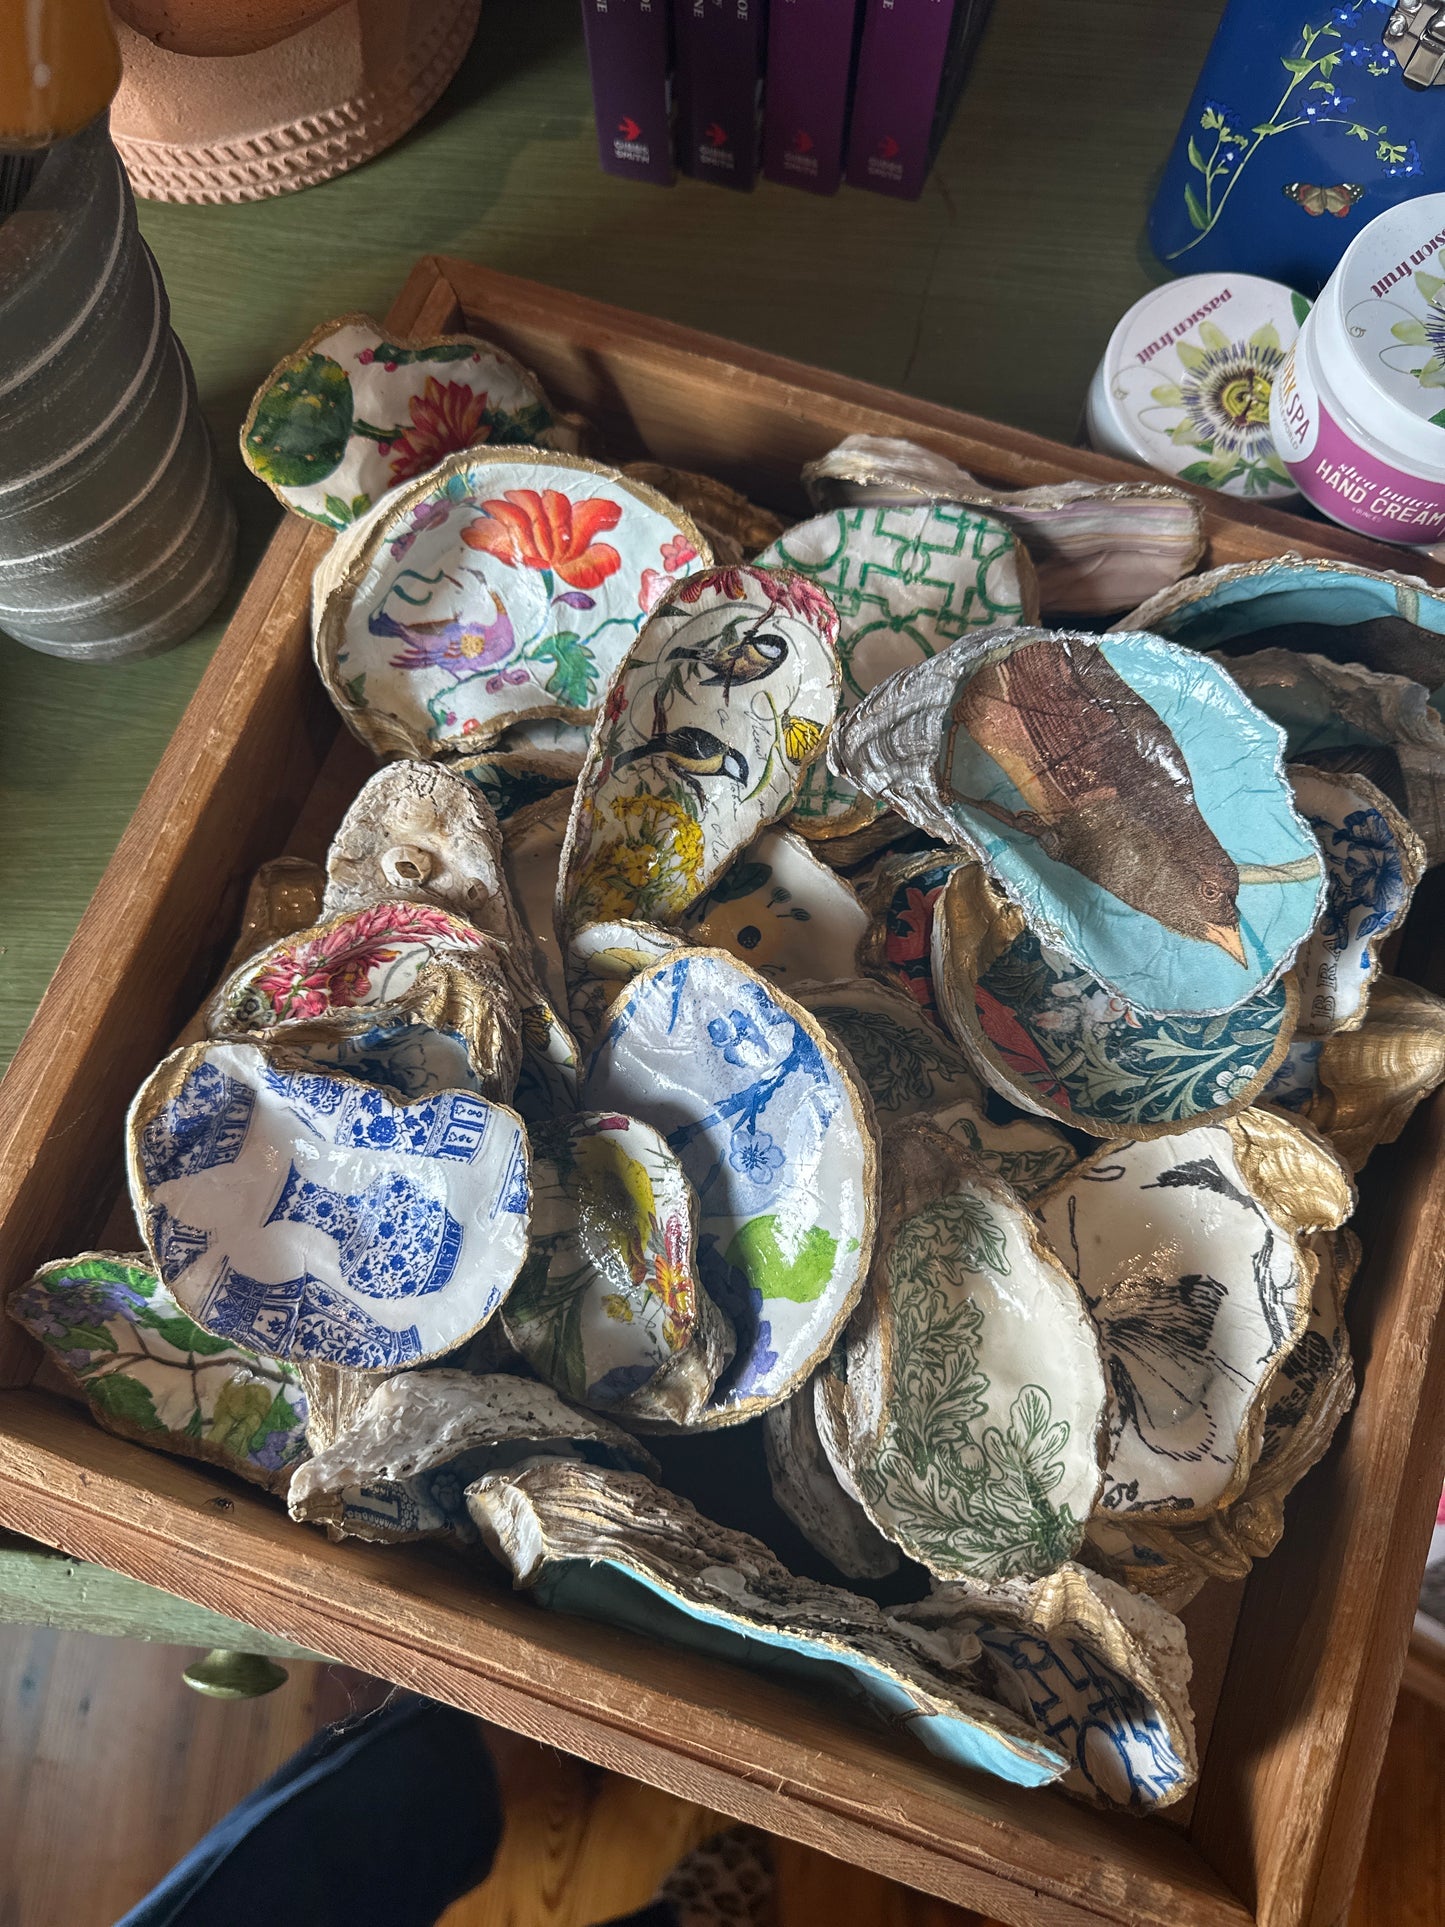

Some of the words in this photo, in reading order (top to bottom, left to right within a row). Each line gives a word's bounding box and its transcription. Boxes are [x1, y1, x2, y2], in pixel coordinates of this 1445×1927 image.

[1370, 261, 1412, 298] fruit
[1173, 288, 1232, 336] passion
[1136, 332, 1175, 365] fruit
[1286, 392, 1310, 444] SPA
[1315, 459, 1367, 504] HAND
[1370, 497, 1445, 526] CREAM
